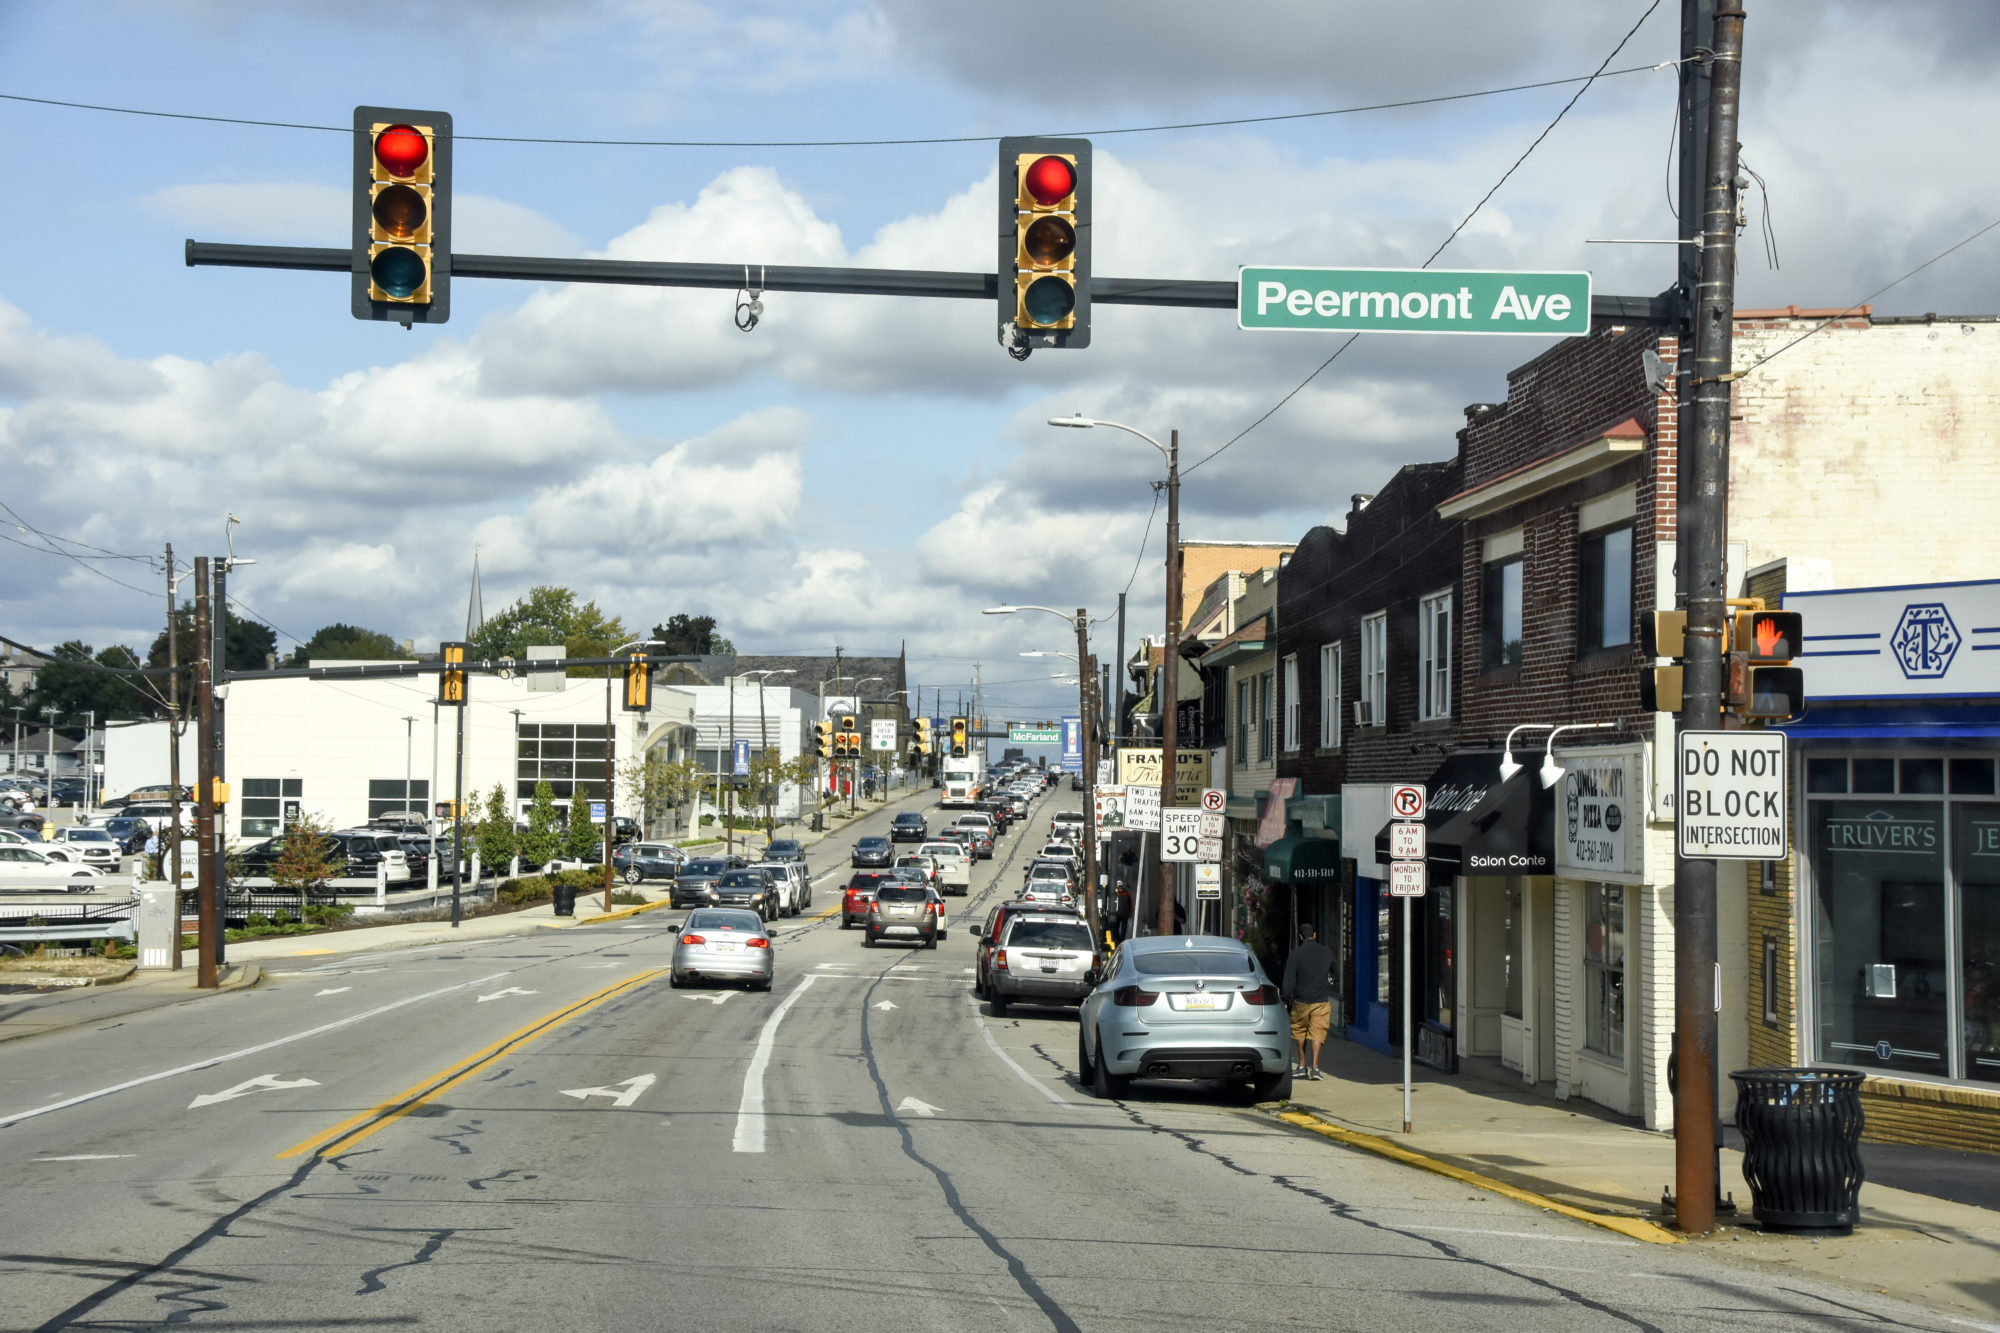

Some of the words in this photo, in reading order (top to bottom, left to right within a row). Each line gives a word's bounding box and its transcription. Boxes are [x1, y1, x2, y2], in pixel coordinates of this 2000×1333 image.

[1257, 281, 1473, 320] Peermont
[1490, 285, 1571, 321] Ave
[1013, 732, 1059, 741] McFarland
[1685, 748, 1720, 776] DO
[1731, 749, 1781, 777] NOT
[1131, 788, 1145, 796] TWO
[1134, 798, 1161, 807] TRAFFIC
[1686, 790, 1779, 817] BLOCK
[1165, 814, 1200, 823] SPEED
[1583, 804, 1602, 828] PIZZA
[1169, 825, 1196, 833] LIMIT
[1686, 825, 1780, 845] INTERSECTION
[1827, 825, 1936, 846] TRUVER'S
[1166, 836, 1198, 855] 30
[1405, 847, 1417, 855] AM
[1470, 855, 1506, 867] Salon
[1508, 854, 1546, 866] Conte
[1396, 884, 1420, 892] FRIDAY
